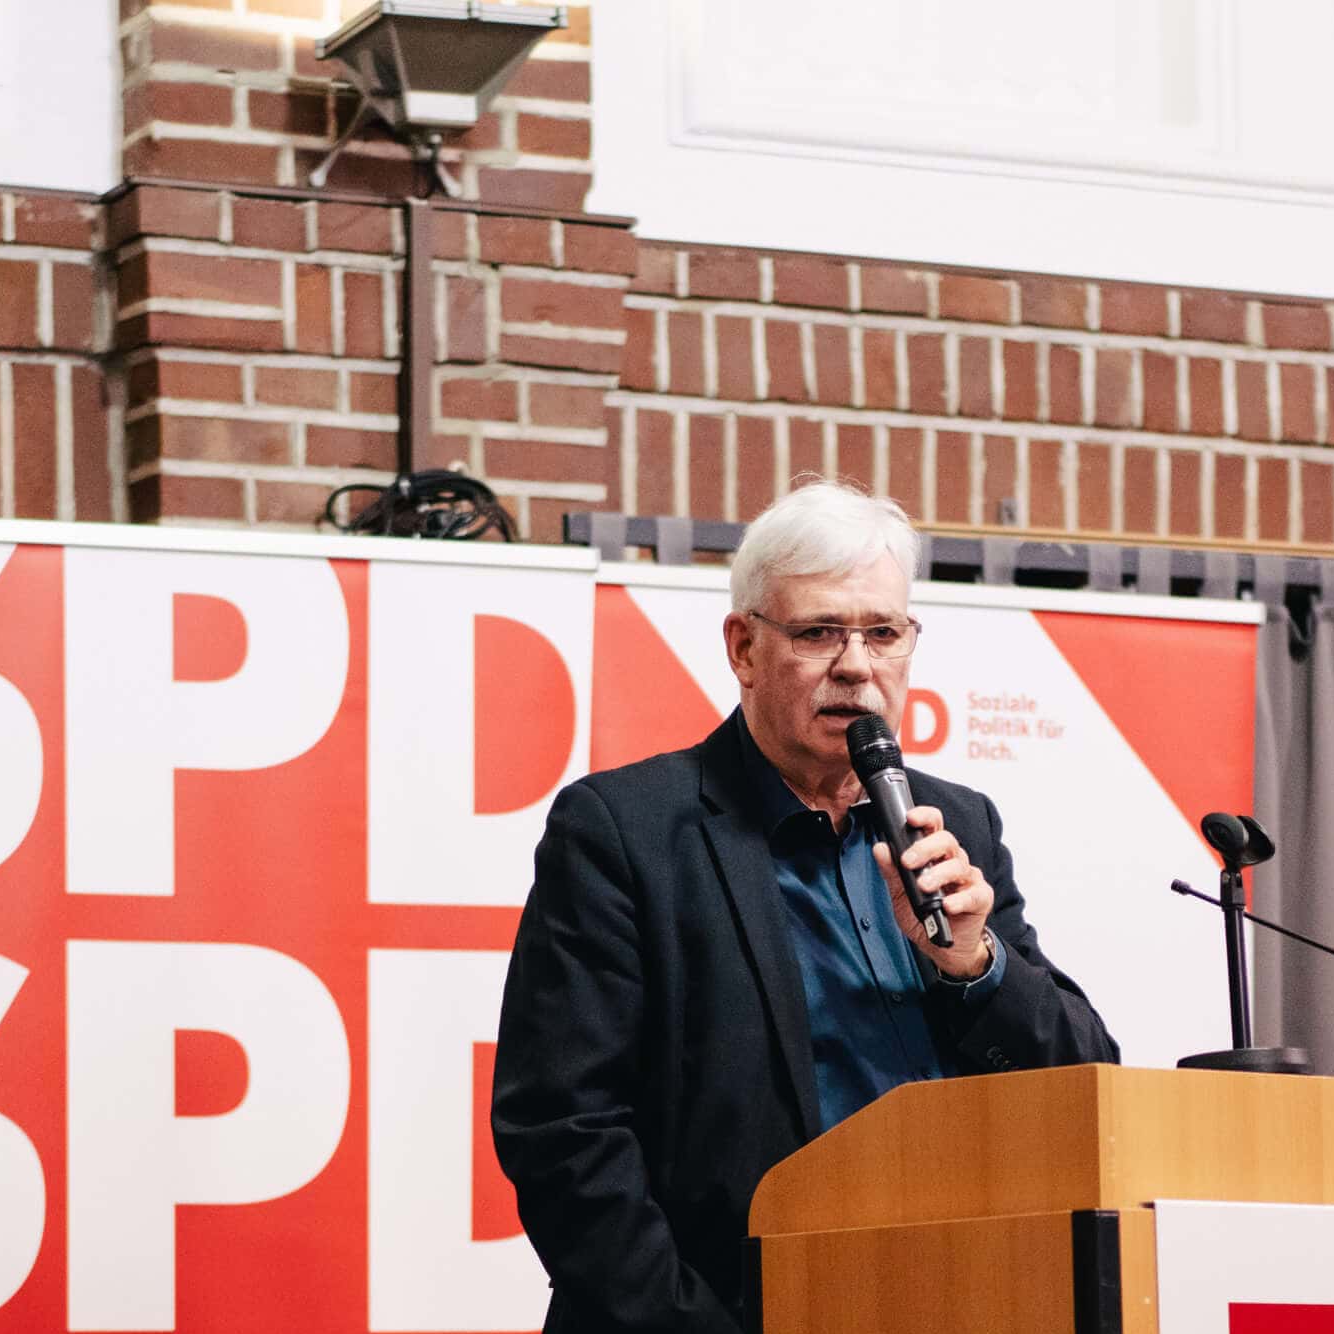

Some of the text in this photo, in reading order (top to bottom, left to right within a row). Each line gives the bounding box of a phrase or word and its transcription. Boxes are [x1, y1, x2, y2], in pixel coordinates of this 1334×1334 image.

[968, 691, 1035, 712] Soziale
[968, 716, 1065, 738] Politik für
[968, 741, 1017, 760] Dich.
